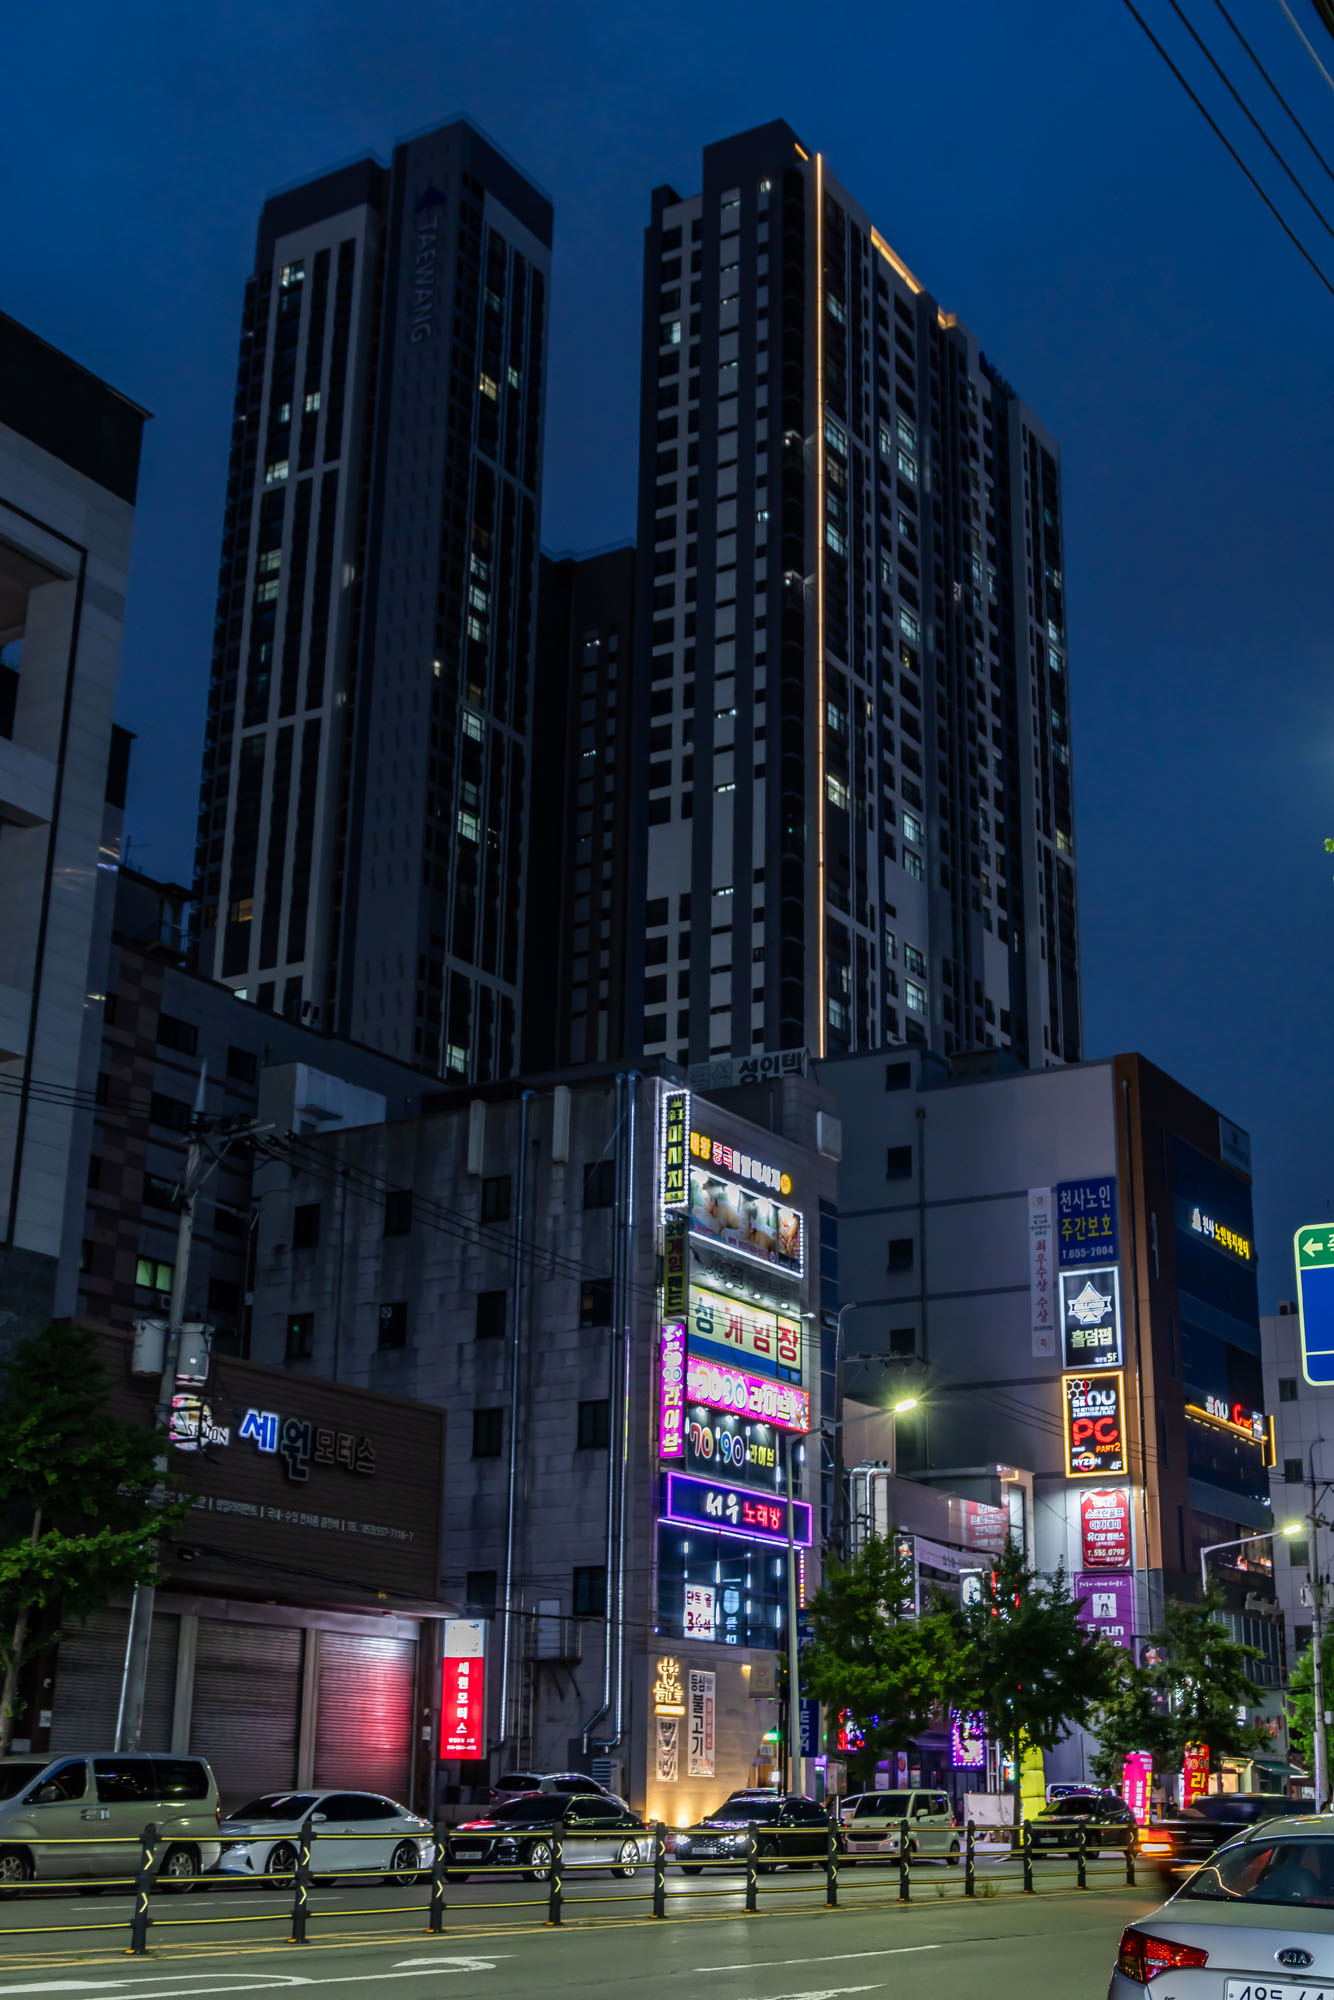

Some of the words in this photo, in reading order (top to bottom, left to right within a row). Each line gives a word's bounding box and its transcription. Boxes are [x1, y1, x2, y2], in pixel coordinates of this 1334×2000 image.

[410, 214, 438, 344] TAEWANG
[667, 1123, 683, 1188] 마사지
[1060, 1185, 1112, 1213] 천사노인
[1061, 1213, 1113, 1243] 주간보호
[1071, 1327, 1112, 1348] 홀덤펍
[1072, 1416, 1118, 1446] PC
[748, 1444, 779, 1468] 라이브
[744, 1501, 781, 1531] 노래방
[1086, 1508, 1124, 1519] 스크린골프
[1090, 1520, 1121, 1530] 아카데미
[455, 1662, 469, 1734] 세원모터스
[692, 1693, 705, 1757] 불고기
[1283, 1953, 1307, 1966] KIA
